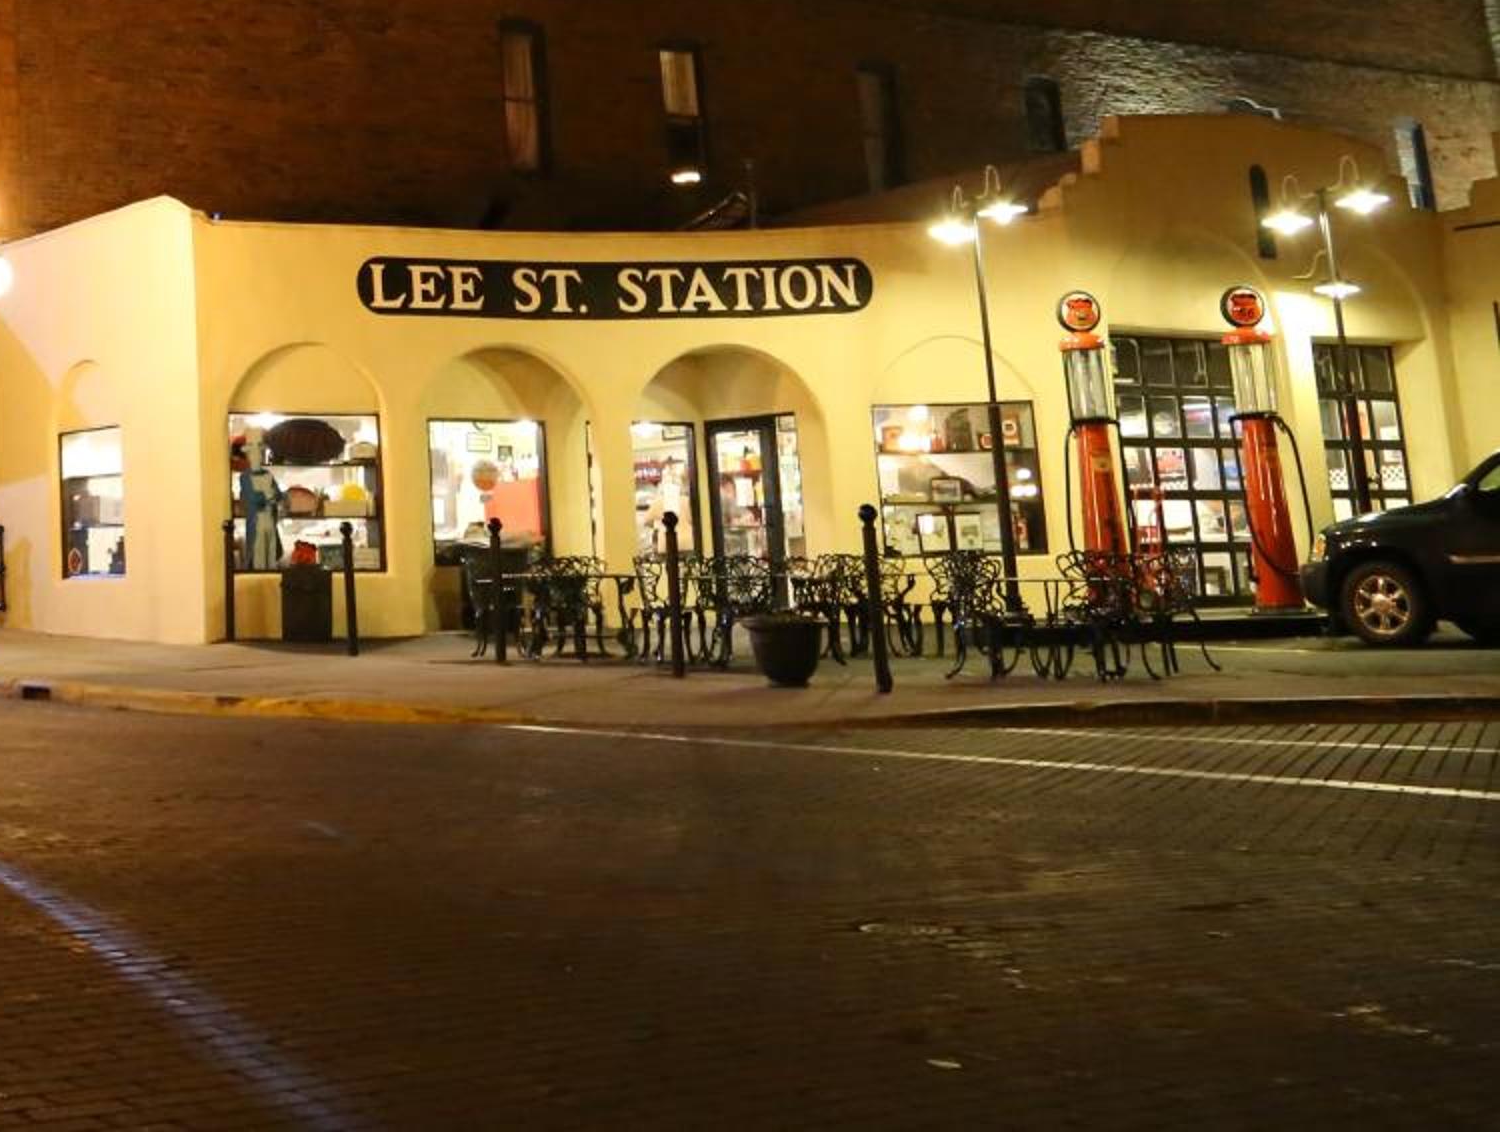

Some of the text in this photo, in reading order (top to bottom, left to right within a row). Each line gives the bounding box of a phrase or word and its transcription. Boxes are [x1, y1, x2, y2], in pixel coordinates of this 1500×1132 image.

[369, 264, 861, 314] LEE ST. STATION
